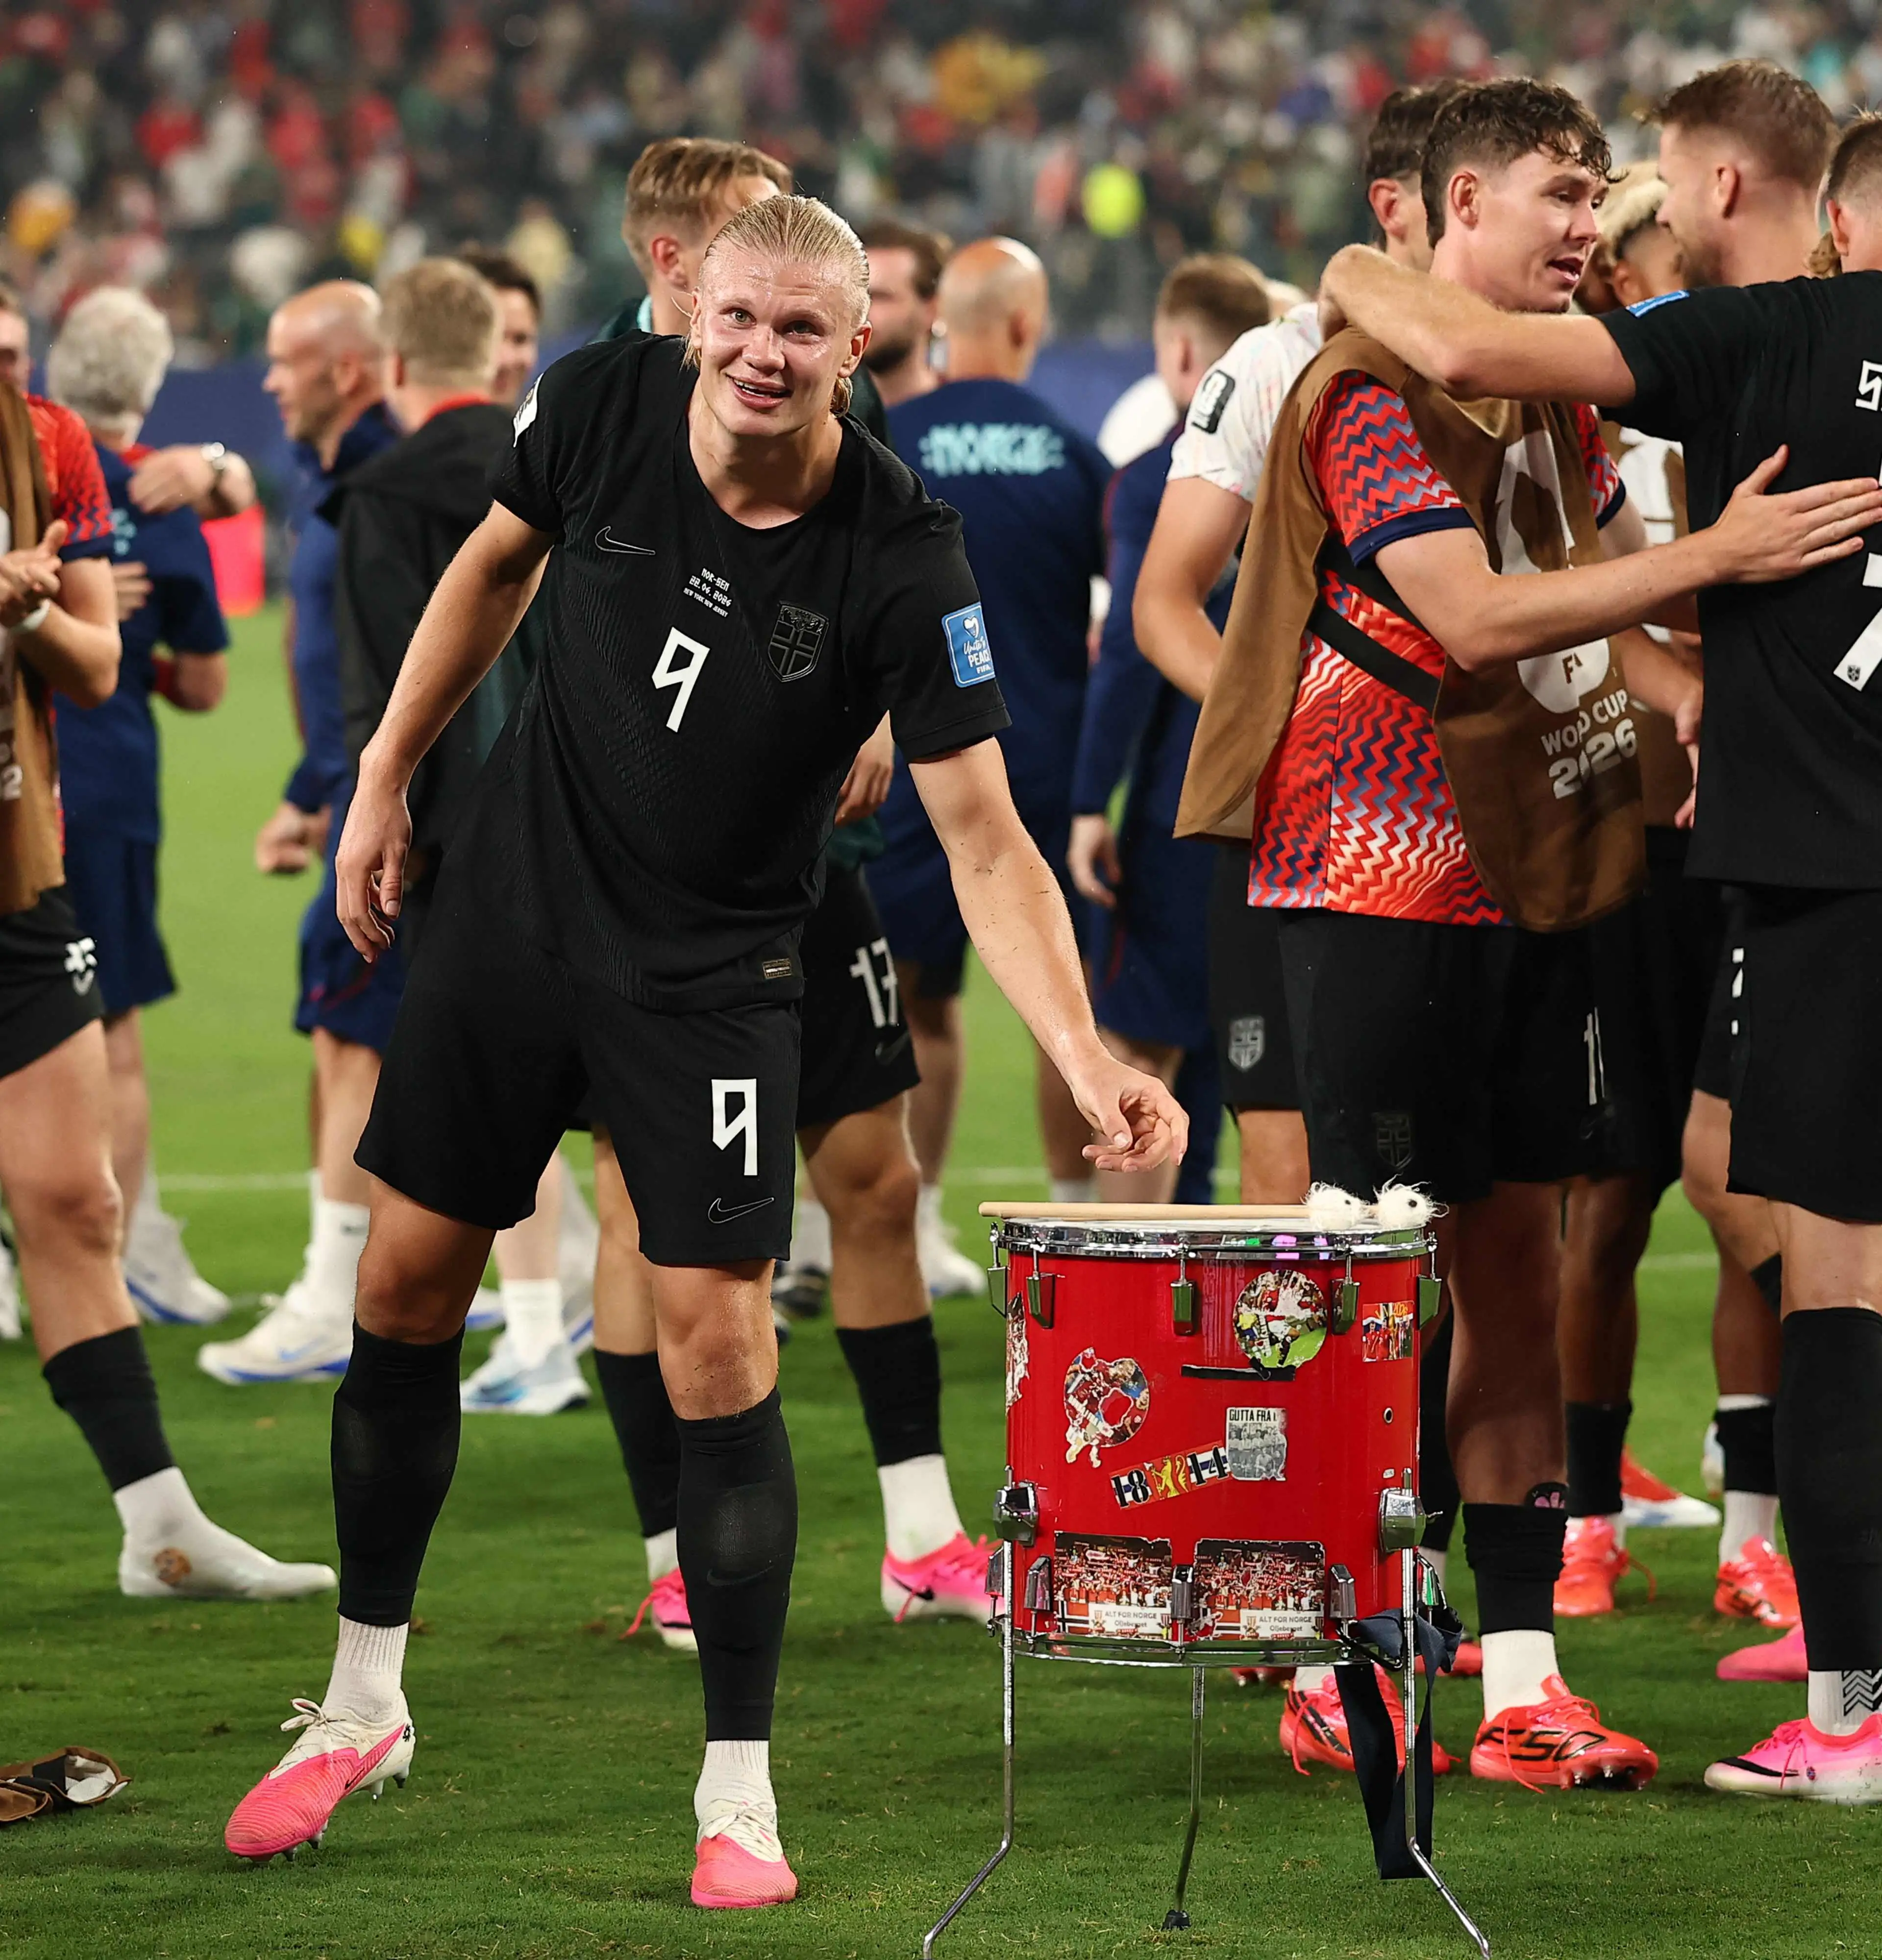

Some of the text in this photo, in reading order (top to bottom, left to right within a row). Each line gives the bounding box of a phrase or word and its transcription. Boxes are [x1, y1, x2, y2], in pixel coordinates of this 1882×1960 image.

[701, 568, 730, 591] NOR-SEN
[651, 627, 711, 733] 9
[976, 664, 991, 674] FIFA
[1592, 688, 1628, 724] CUP
[849, 936, 898, 1028] 17
[711, 1078, 757, 1176] 9
[1229, 1409, 1254, 1421] GUTTA
[1257, 1410, 1271, 1421] FRA
[1111, 1446, 1228, 1507] 18 14
